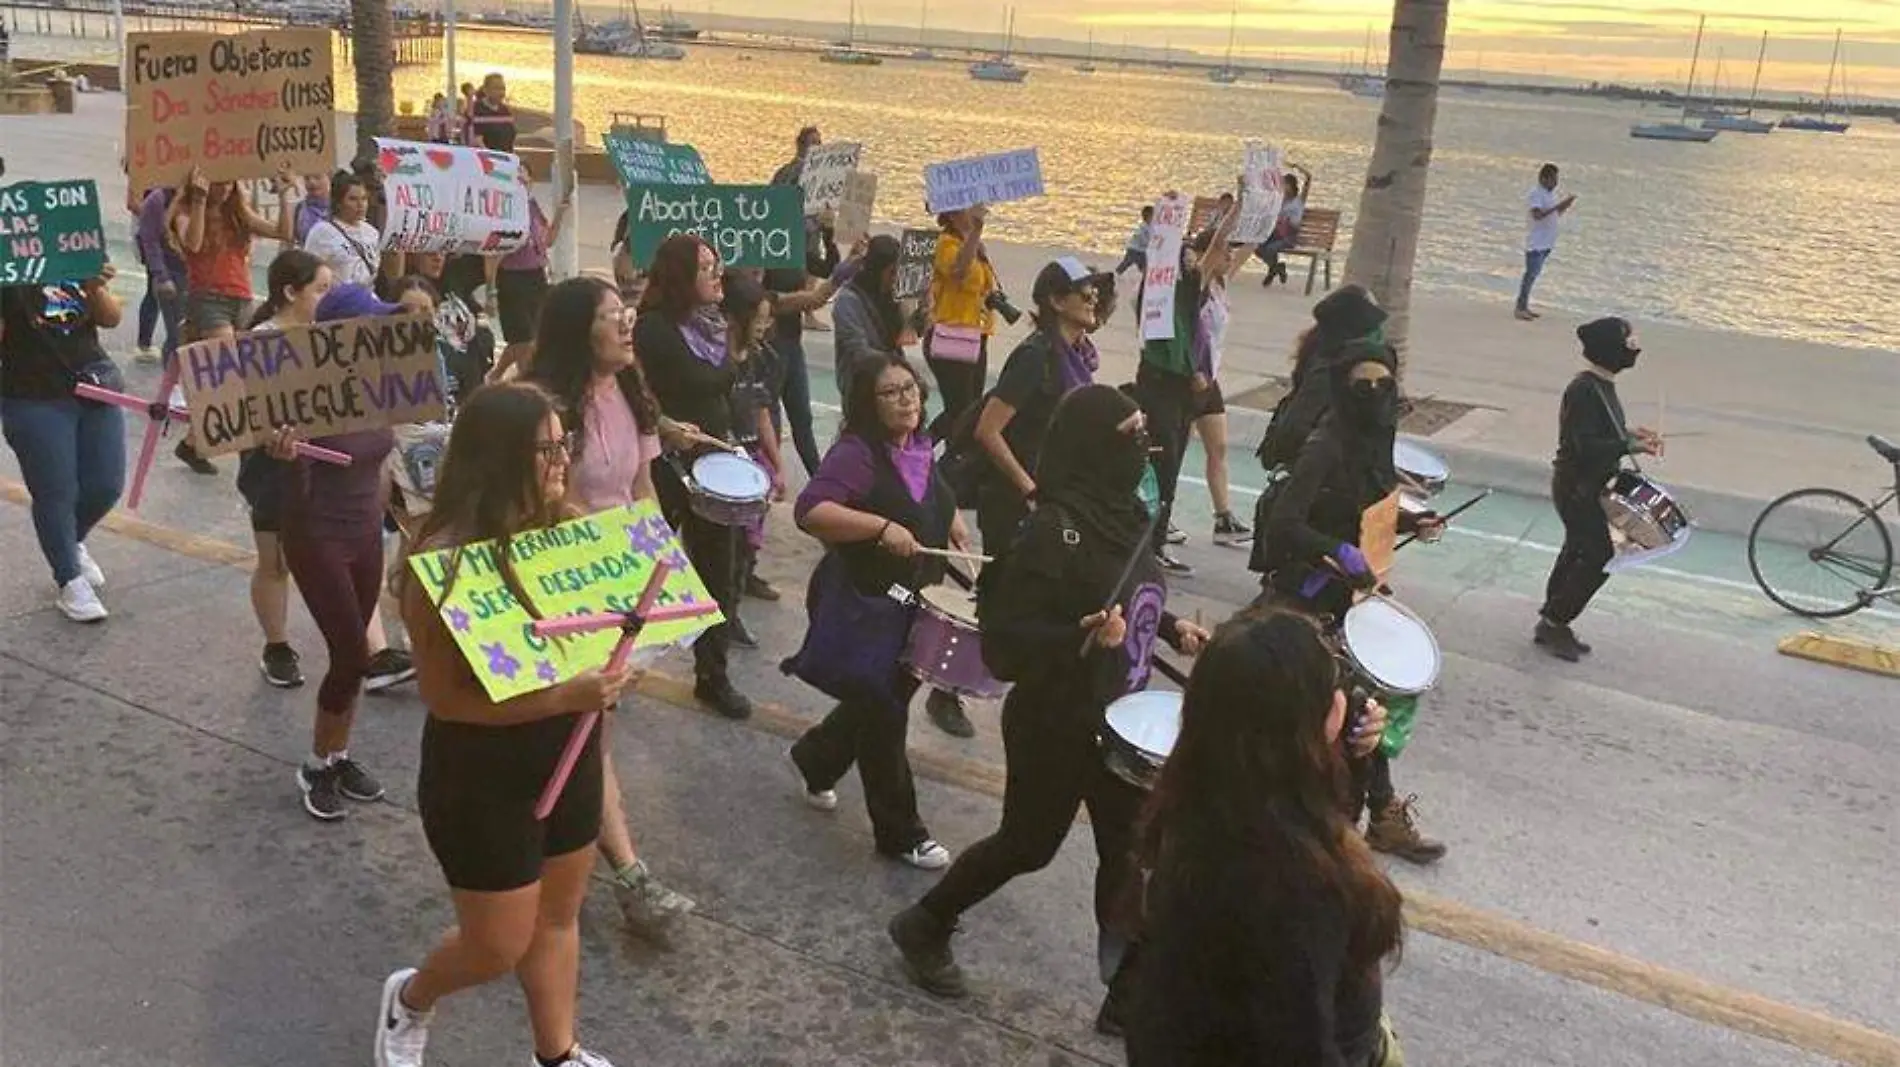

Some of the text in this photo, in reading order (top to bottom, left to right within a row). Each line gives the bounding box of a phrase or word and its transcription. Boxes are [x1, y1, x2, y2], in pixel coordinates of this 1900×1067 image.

[134, 37, 313, 84] Fuera Objetoras
[257, 116, 325, 162] (ISSSTE)
[44, 185, 88, 209] SON
[639, 189, 770, 223] Aborta tu
[12, 229, 100, 257] NO SON
[187, 332, 303, 390] HARTA
[308, 324, 348, 368] DE
[202, 395, 263, 446] QUE
[361, 369, 444, 410] VIVA
[538, 552, 642, 596] DESEADA
